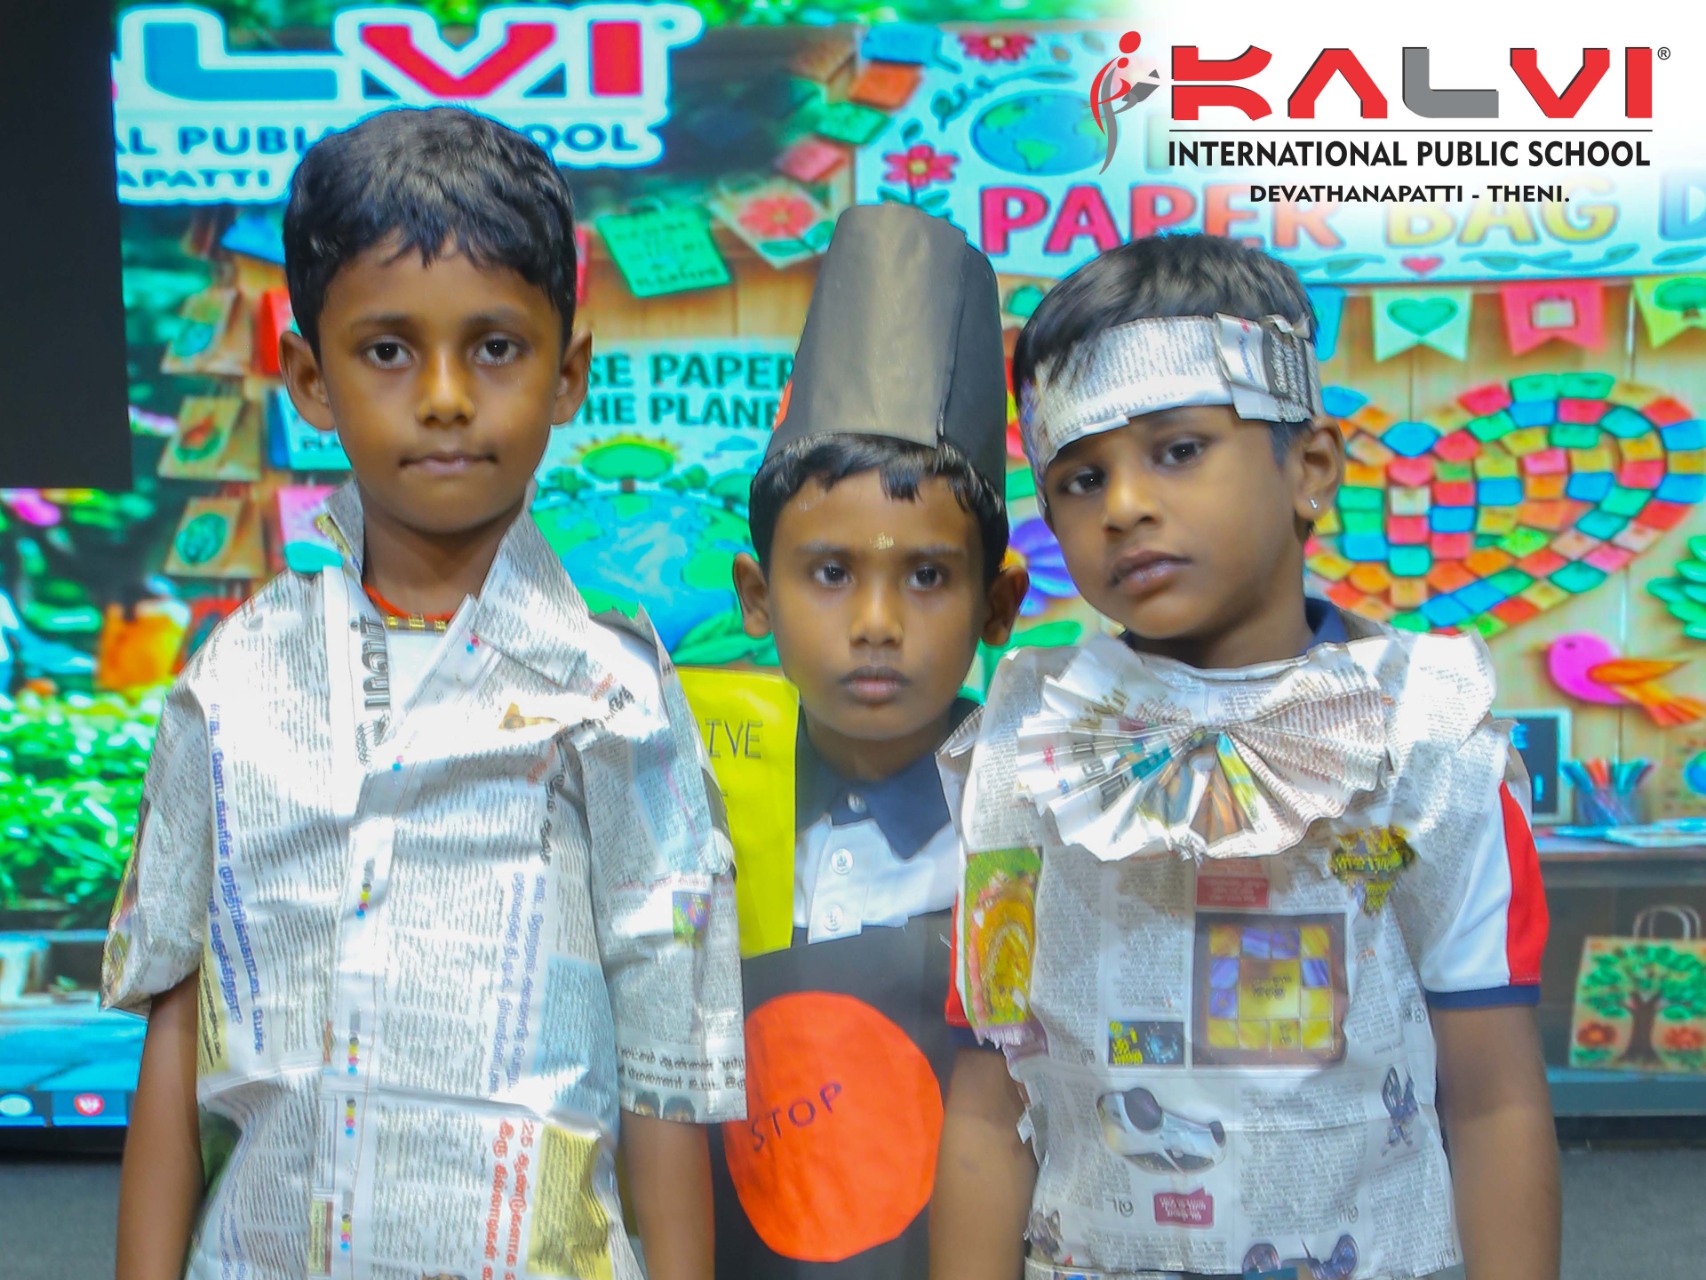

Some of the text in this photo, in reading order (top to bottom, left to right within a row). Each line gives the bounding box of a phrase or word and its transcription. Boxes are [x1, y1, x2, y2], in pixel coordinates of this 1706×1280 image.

[143, 21, 642, 101] LVI
[980, 183, 1345, 255] PAPER
[1384, 176, 1619, 249] BAG
[650, 393, 781, 432] PLANE
[705, 718, 764, 761] IVE
[752, 1080, 844, 1153] STOP
